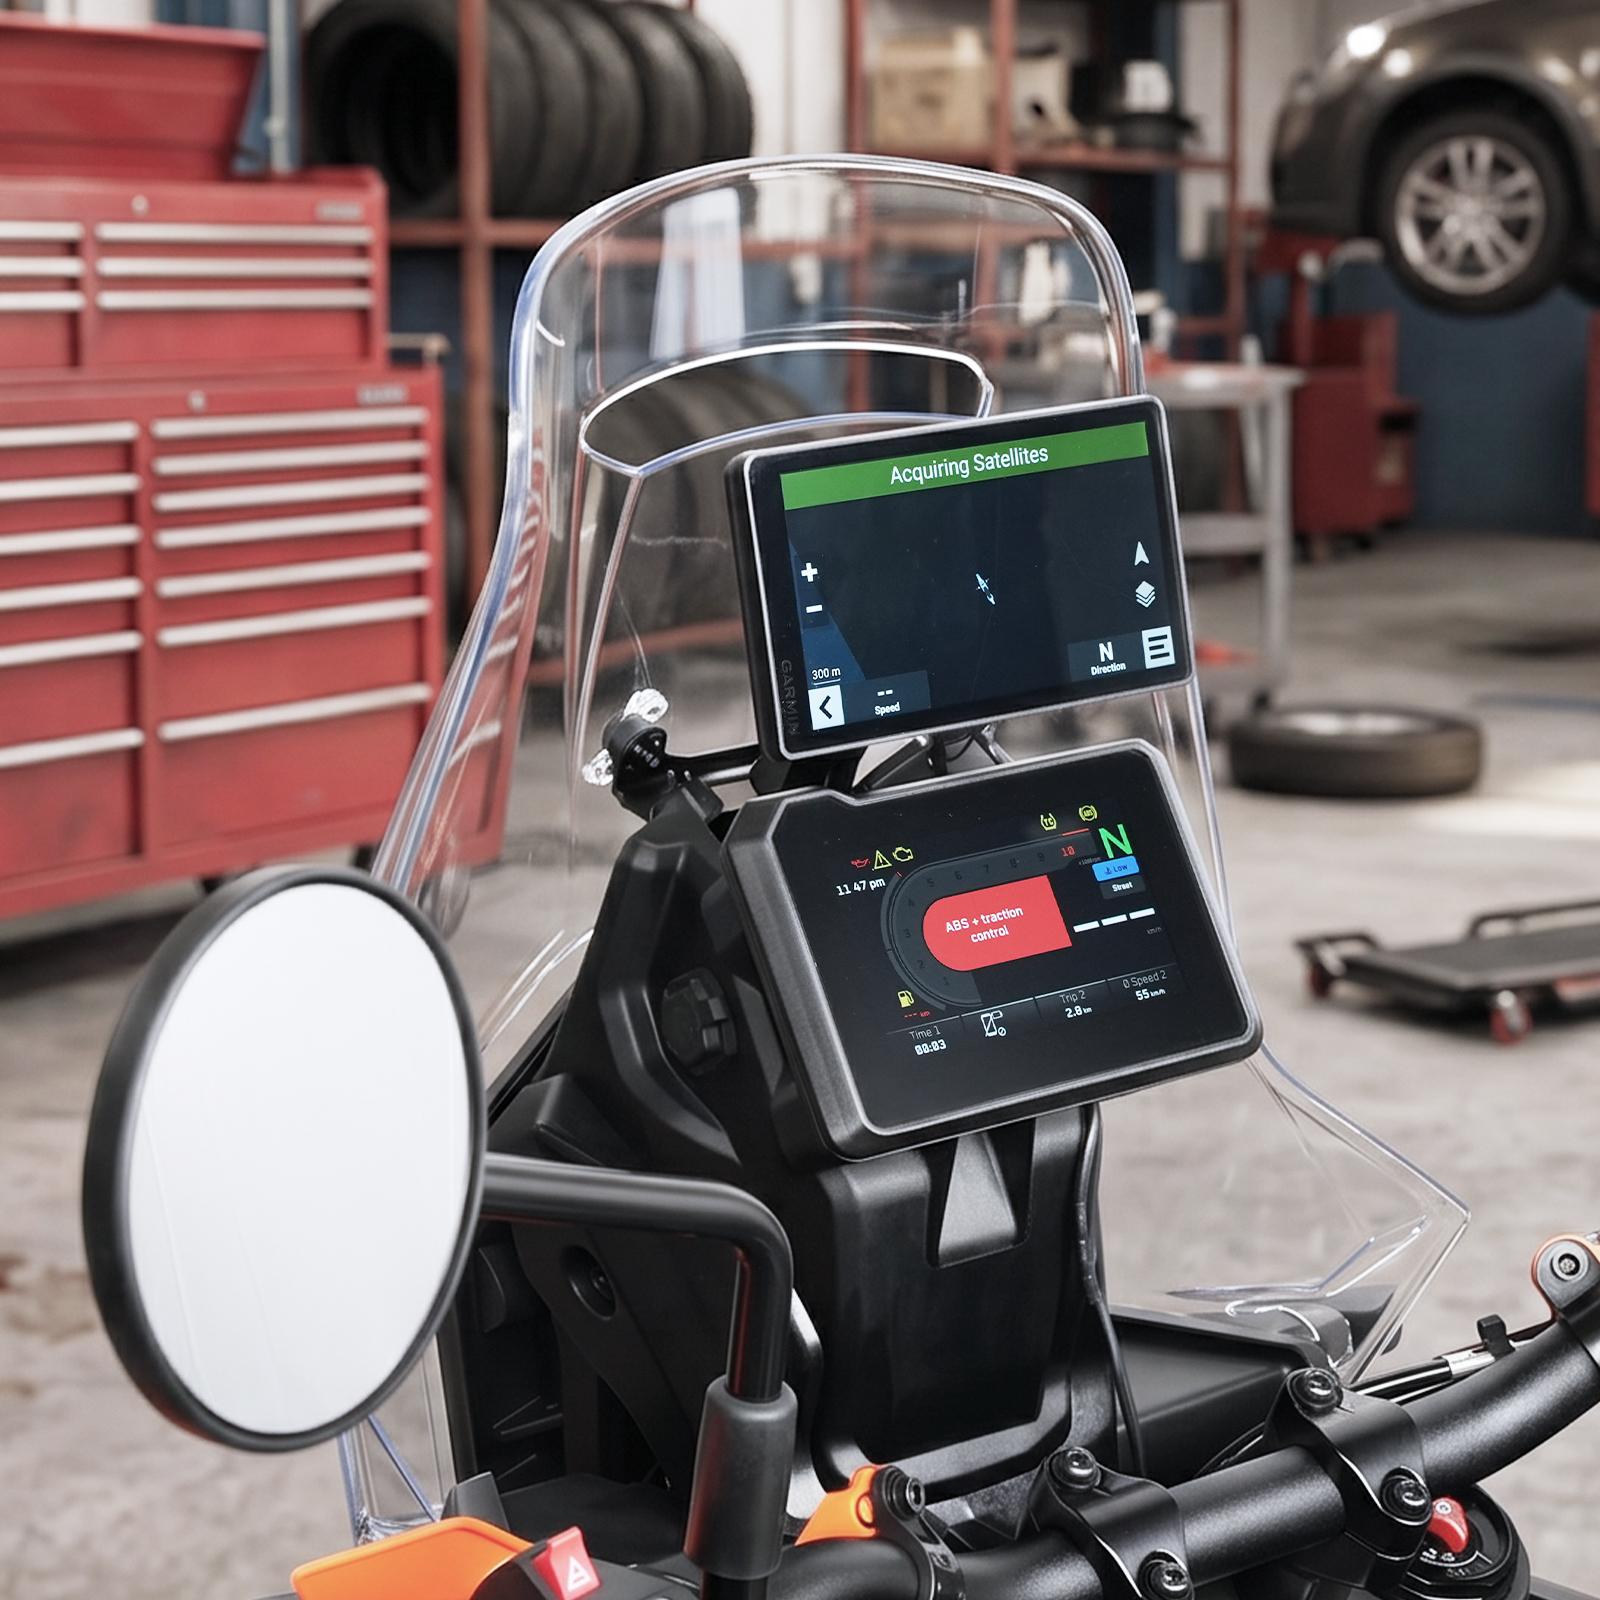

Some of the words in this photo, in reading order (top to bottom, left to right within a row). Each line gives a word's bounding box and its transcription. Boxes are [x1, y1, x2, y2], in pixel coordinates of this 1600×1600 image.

[891, 459, 970, 485] Acquiring
[973, 447, 1049, 472] Satellites
[1098, 641, 1114, 663] N
[811, 667, 830, 681] 300
[831, 666, 841, 677] m
[1090, 662, 1127, 676] Direction
[781, 659, 801, 736] GARMIN
[874, 701, 901, 717] Speed
[1098, 823, 1134, 859] N
[1061, 845, 1076, 857] 10
[869, 877, 886, 891] pm
[1112, 881, 1133, 892] Street
[945, 917, 969, 933] ABS
[980, 906, 1024, 925] traction
[970, 925, 1009, 943] control
[1130, 972, 1160, 987] Speed
[1160, 969, 1168, 980] 2
[1059, 993, 1079, 1004] Trip
[1078, 990, 1086, 1000] 2
[1135, 988, 1150, 1001] 55
[1065, 1005, 1083, 1018] 2.8
[909, 1028, 933, 1040] Time
[933, 1025, 941, 1035] 1
[914, 1039, 947, 1056] 00:03
